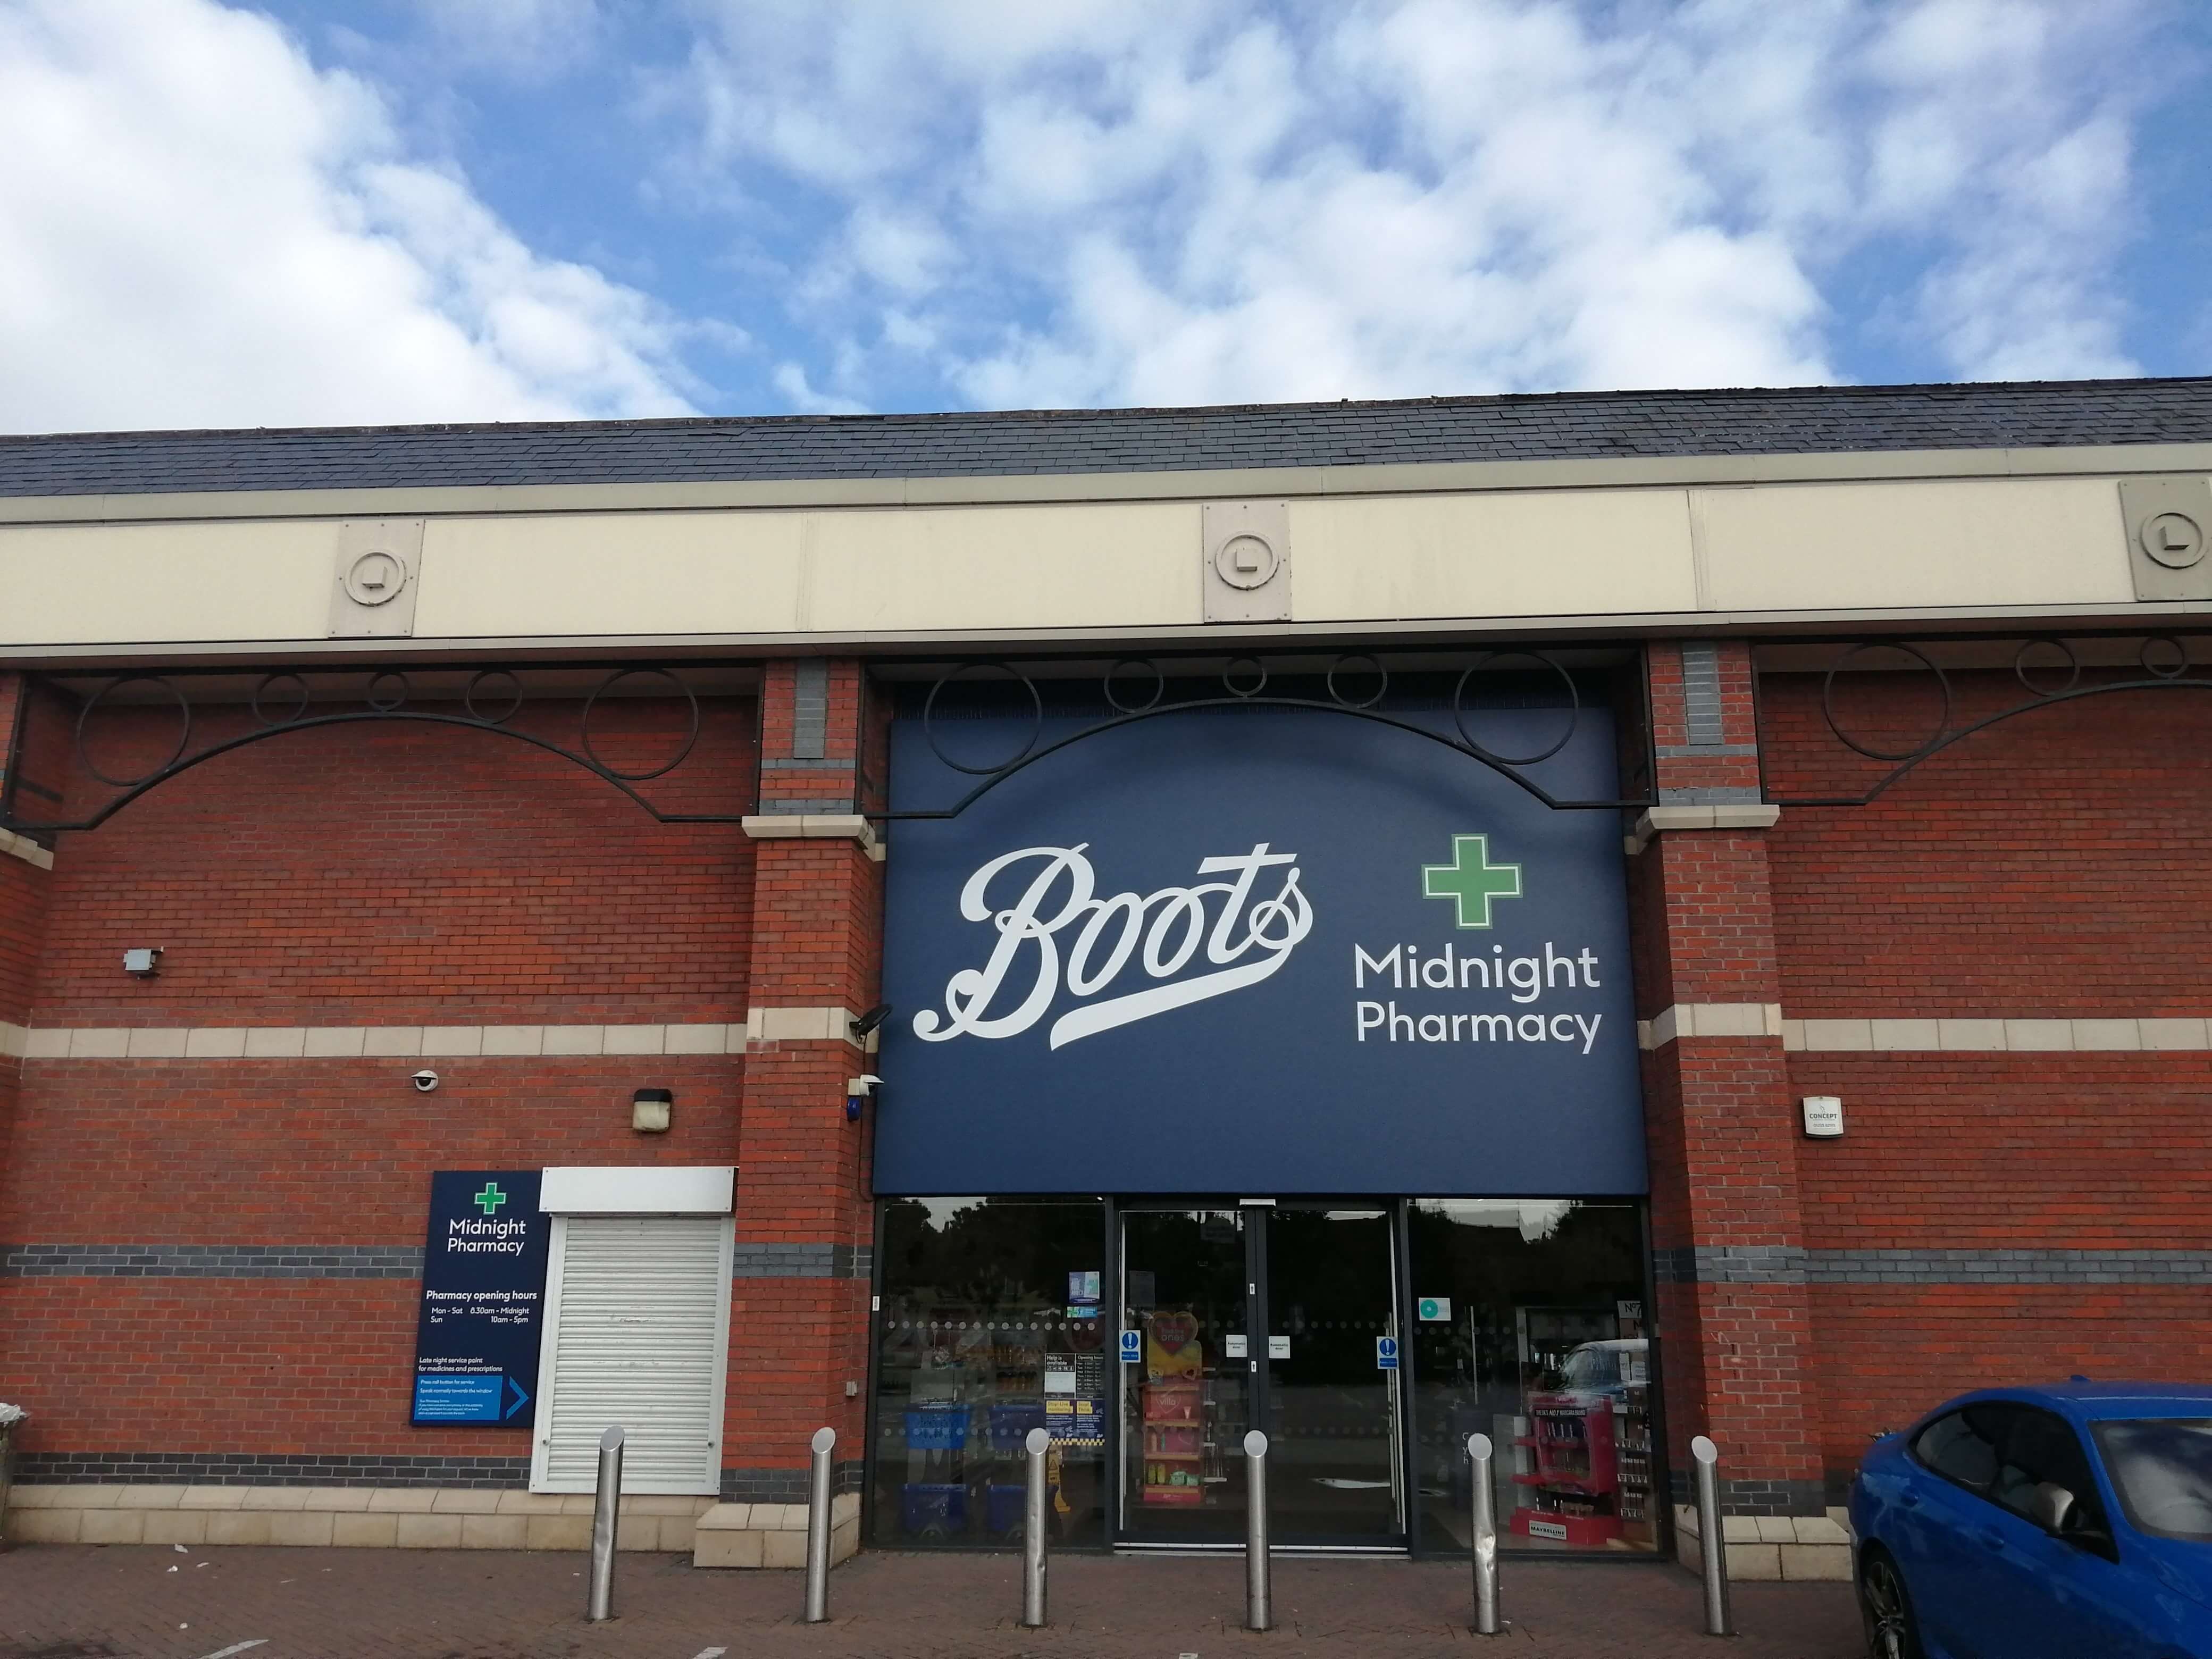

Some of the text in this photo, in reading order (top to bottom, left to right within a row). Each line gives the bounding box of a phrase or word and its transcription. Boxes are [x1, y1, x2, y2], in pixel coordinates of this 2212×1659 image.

[913, 842, 1313, 1051] Boots
[1354, 941, 1601, 1003] Midnight
[1356, 1000, 1602, 1054] Pharmacy
[449, 1218, 526, 1239] Midnight
[447, 1237, 525, 1256] Pharmacy
[426, 1290, 538, 1302] Pharmacy opening hours
[500, 1307, 530, 1316] Midnight
[513, 1316, 529, 1325] 5pm
[432, 1356, 448, 1365] night
[1159, 1397, 1177, 1405] villa
[1531, 1526, 1565, 1536] MAYBELLINE
